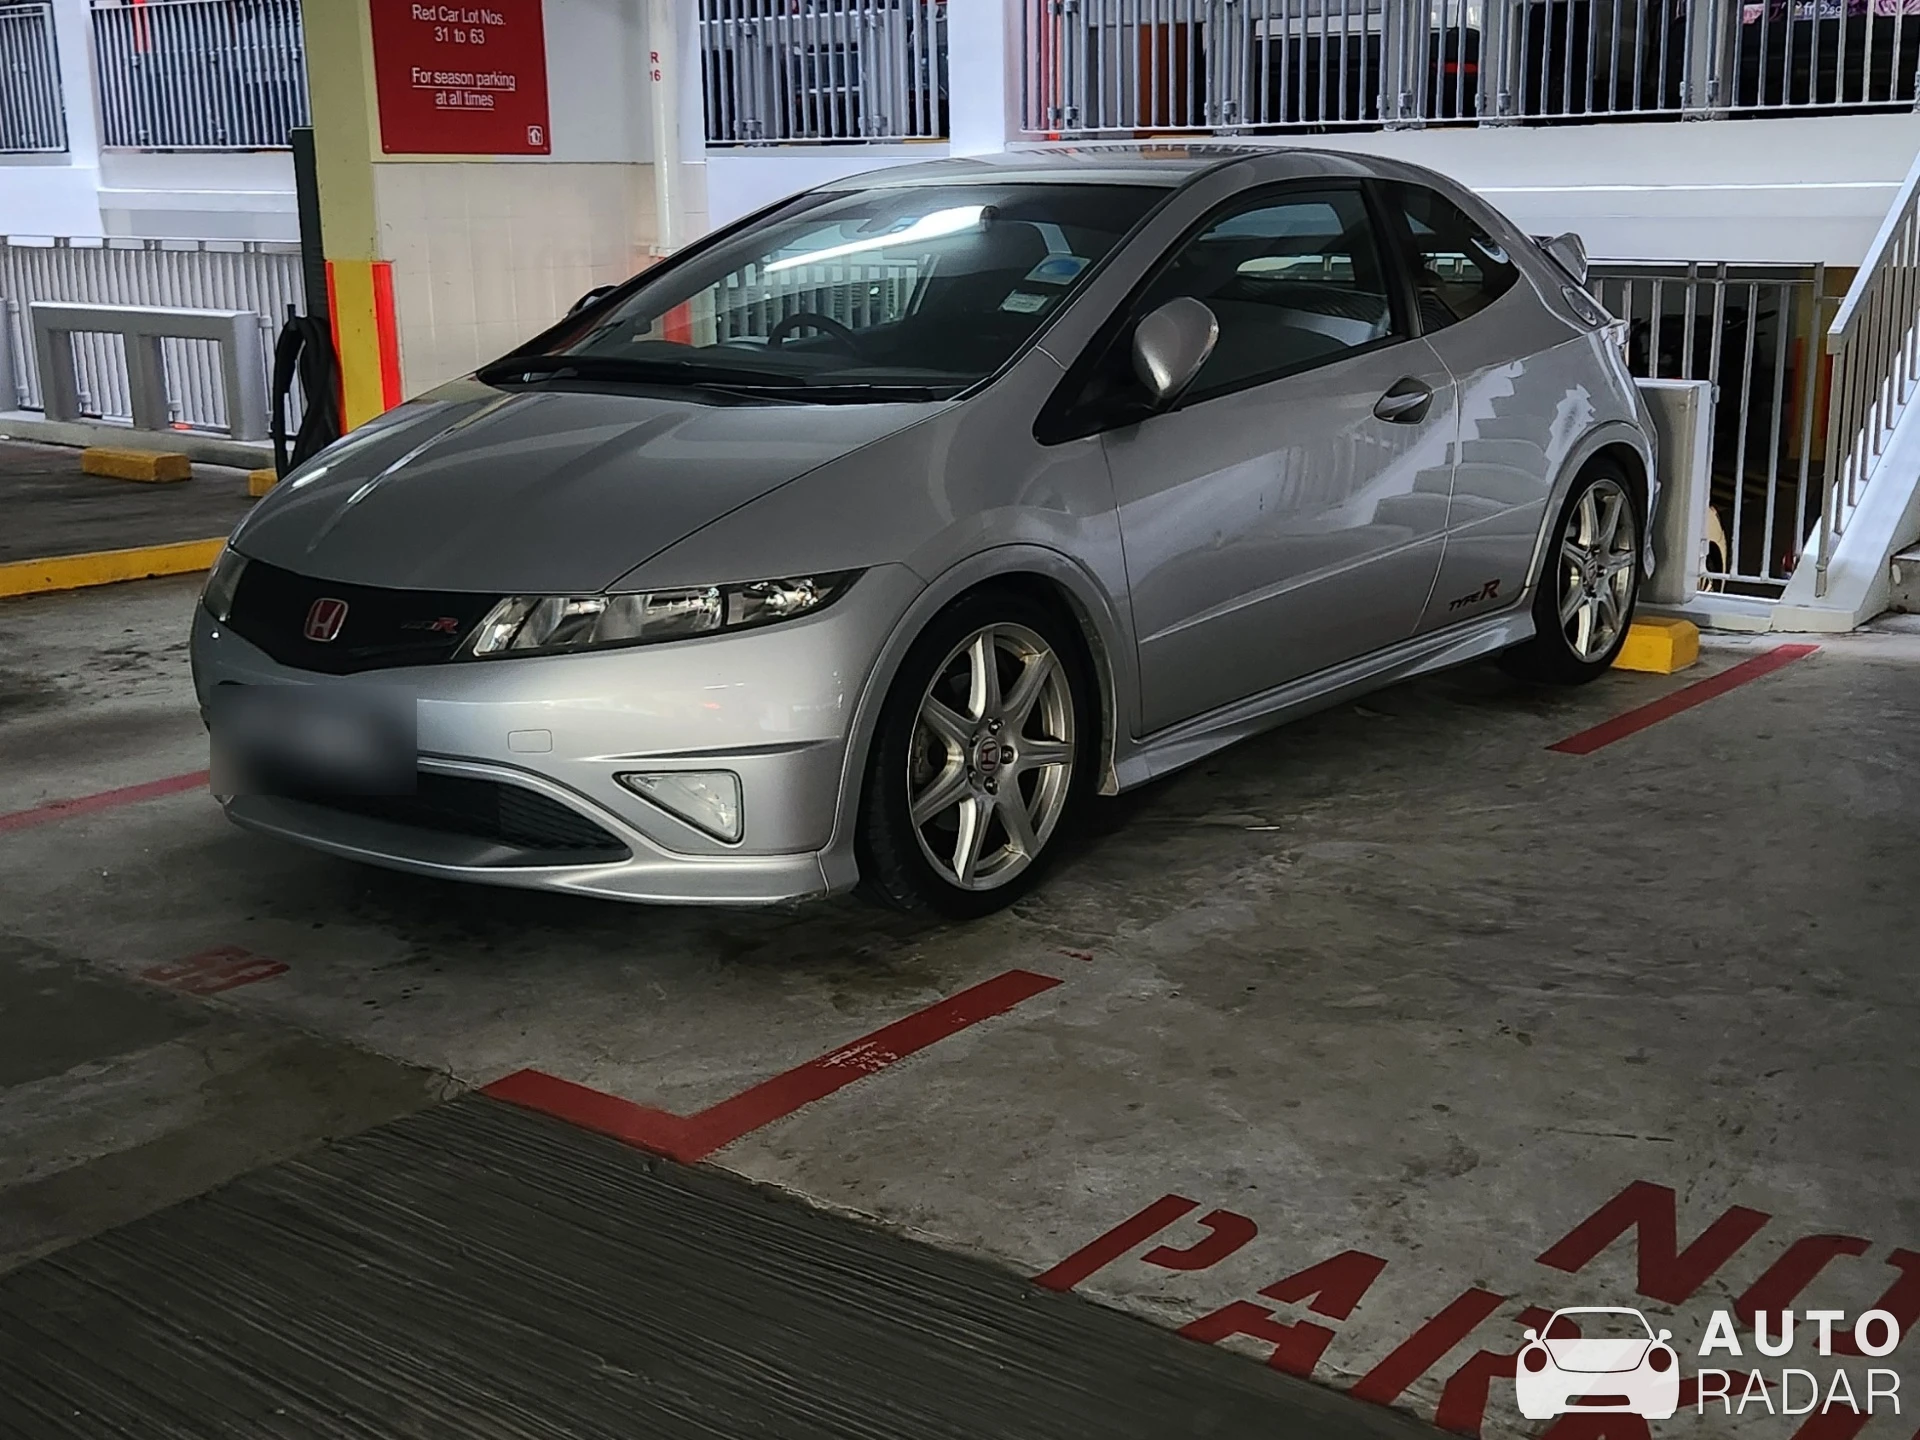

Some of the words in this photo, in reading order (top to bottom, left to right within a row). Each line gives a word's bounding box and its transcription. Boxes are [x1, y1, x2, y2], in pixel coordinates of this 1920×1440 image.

[412, 4, 436, 20] Red
[438, 6, 459, 22] Car
[461, 8, 479, 24] Lot
[481, 9, 506, 25] Nos.
[434, 26, 448, 42] 31
[454, 28, 466, 43] to
[470, 29, 485, 44] 63
[412, 67, 432, 83] For
[433, 71, 474, 85] season
[476, 72, 515, 91] parking
[435, 92, 447, 105] at
[449, 90, 462, 105] all
[464, 91, 494, 107] times
